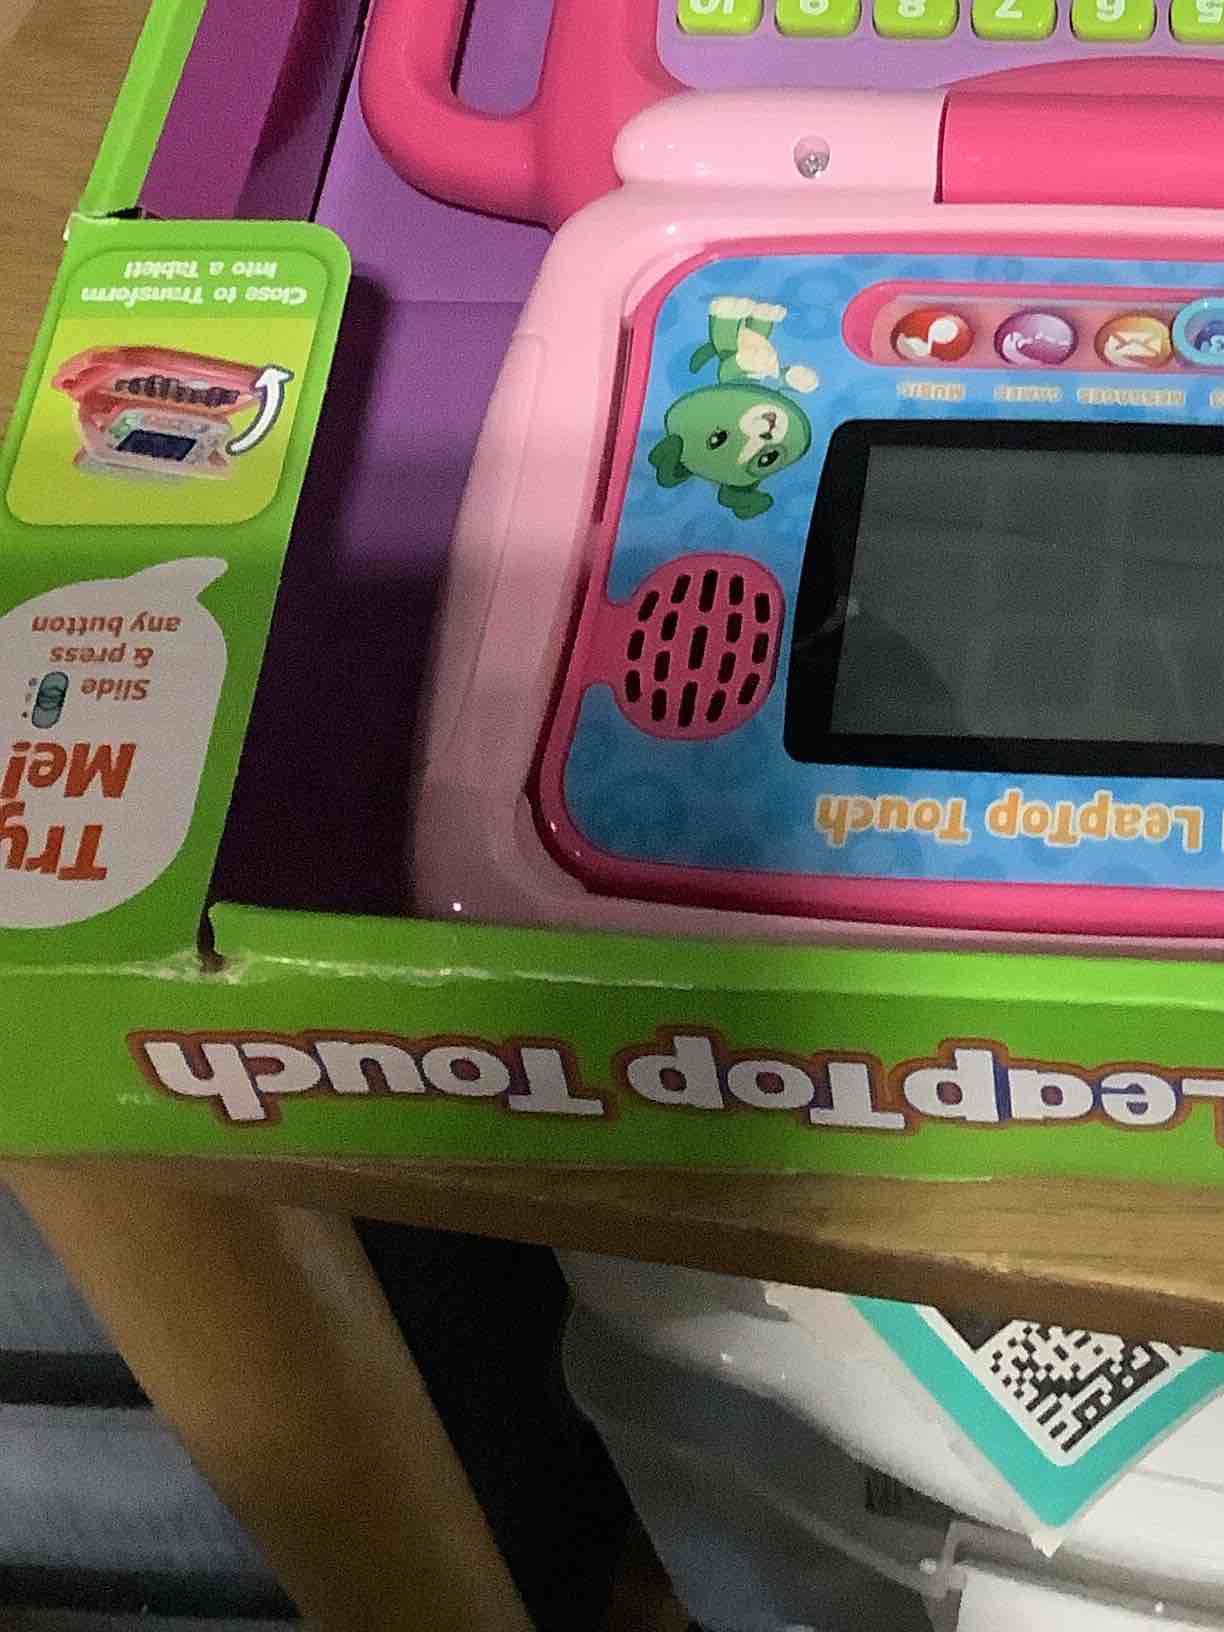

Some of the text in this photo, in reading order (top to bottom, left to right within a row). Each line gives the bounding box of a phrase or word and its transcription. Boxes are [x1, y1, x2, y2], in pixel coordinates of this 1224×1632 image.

[125, 261, 199, 278] Tablet!
[209, 261, 225, 275] a
[82, 287, 307, 306] Close to Transform
[32, 611, 181, 637] any button
[49, 643, 154, 668] & press
[81, 678, 151, 701] Slide
[0, 741, 137, 799] Me!
[816, 795, 969, 849] Touch
[987, 789, 1200, 852] LeapTop
[144, 1042, 604, 1121] Touch
